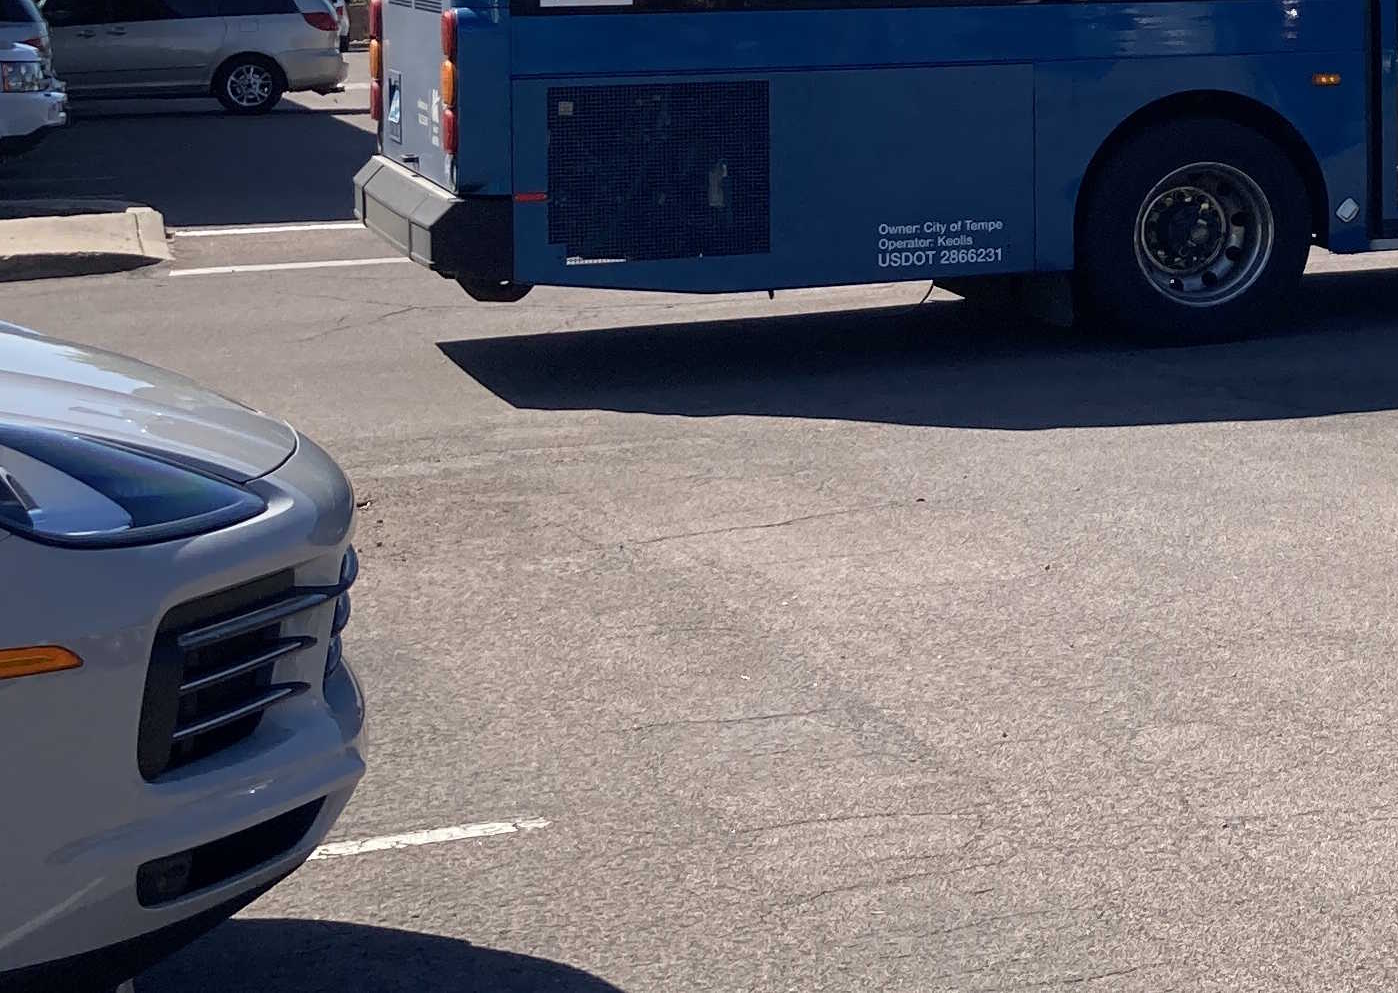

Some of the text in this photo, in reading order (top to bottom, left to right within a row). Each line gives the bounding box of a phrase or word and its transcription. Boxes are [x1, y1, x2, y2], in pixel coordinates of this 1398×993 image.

[878, 219, 1004, 235] Owner: City of Tempe
[878, 235, 974, 251] Operator: Keolis
[877, 247, 1002, 267] USDOT 2866231
